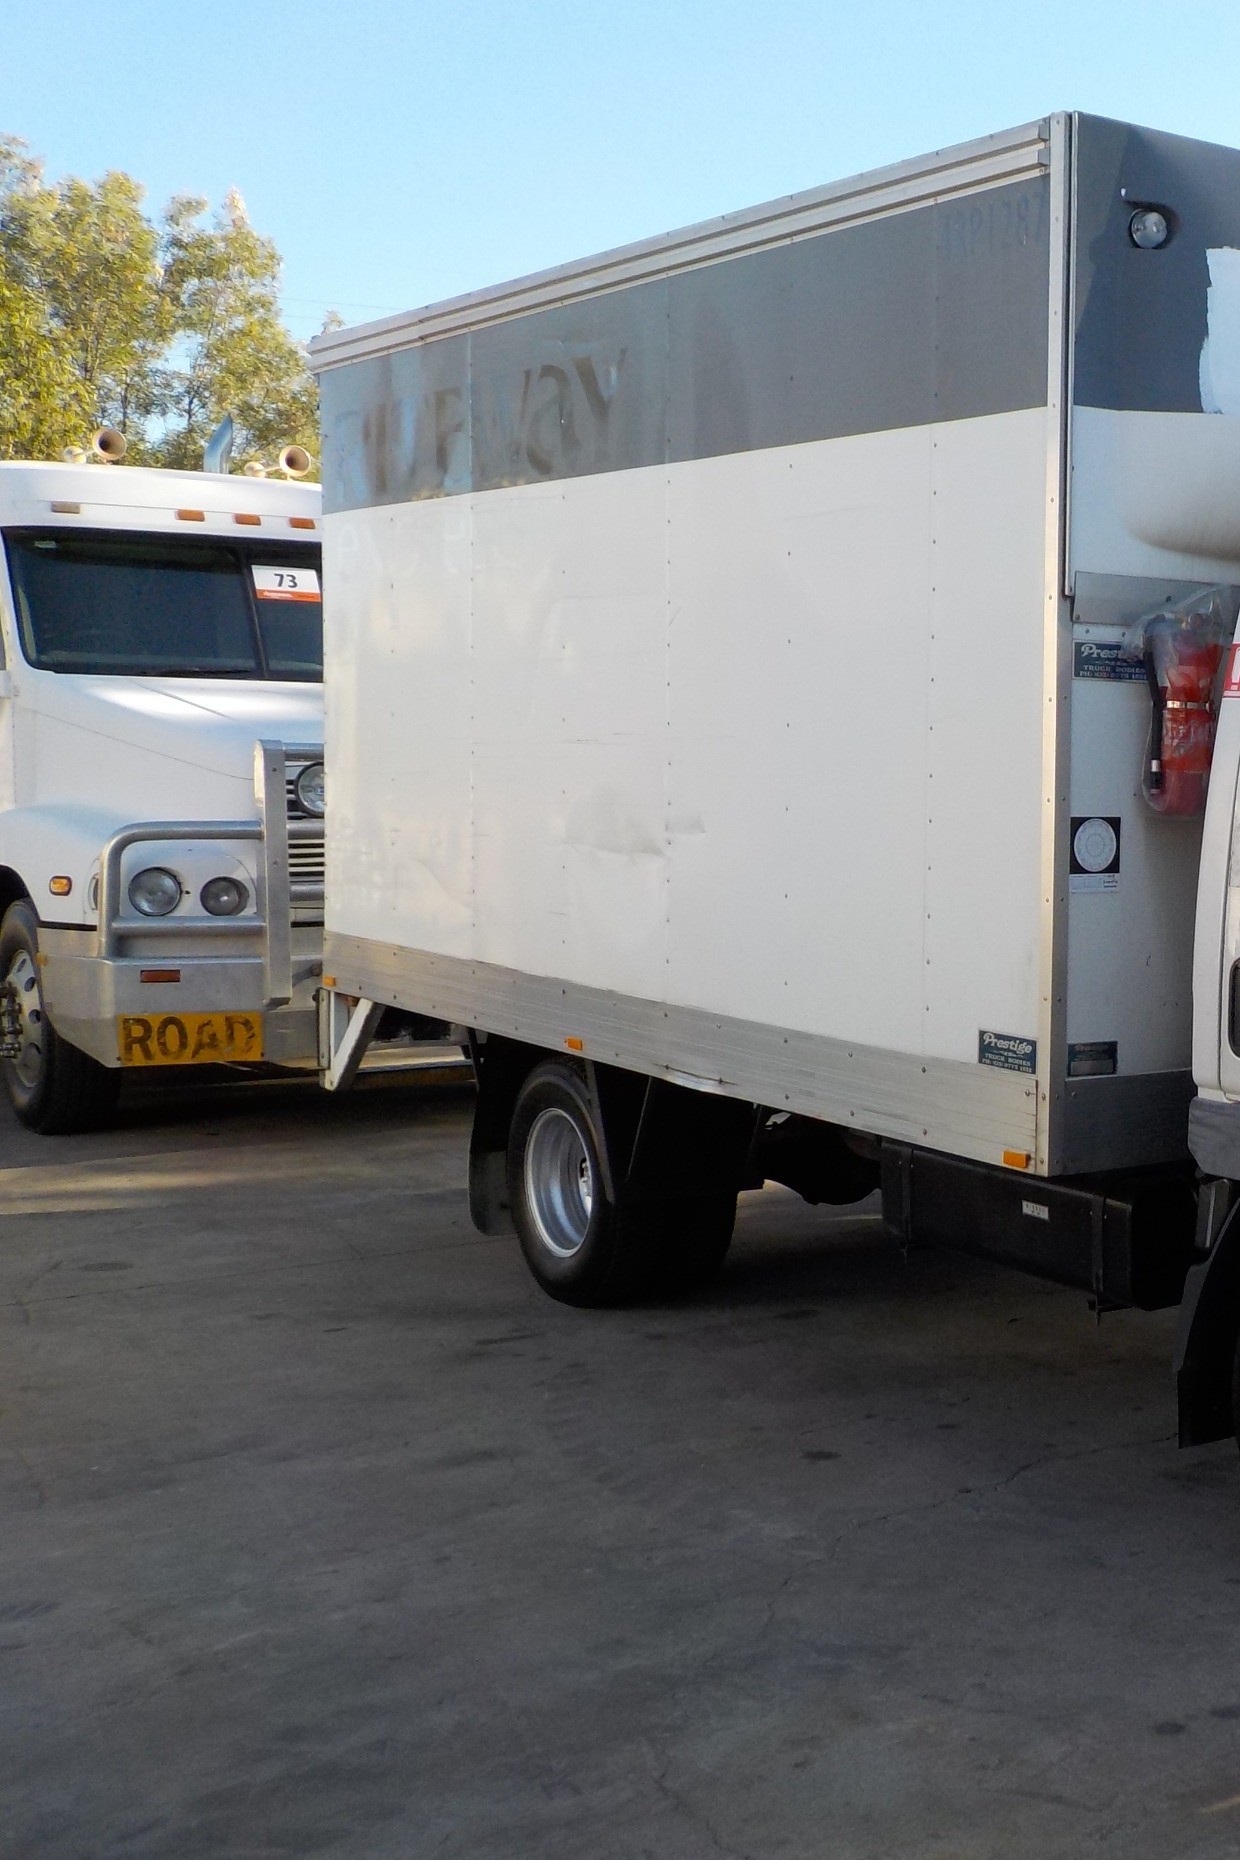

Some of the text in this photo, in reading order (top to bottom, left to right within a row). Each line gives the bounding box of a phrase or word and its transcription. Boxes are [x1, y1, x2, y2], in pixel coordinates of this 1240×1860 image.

[273, 572, 299, 589] 73
[121, 1015, 257, 1063] ROAD
[982, 1032, 1033, 1055] Prestige
